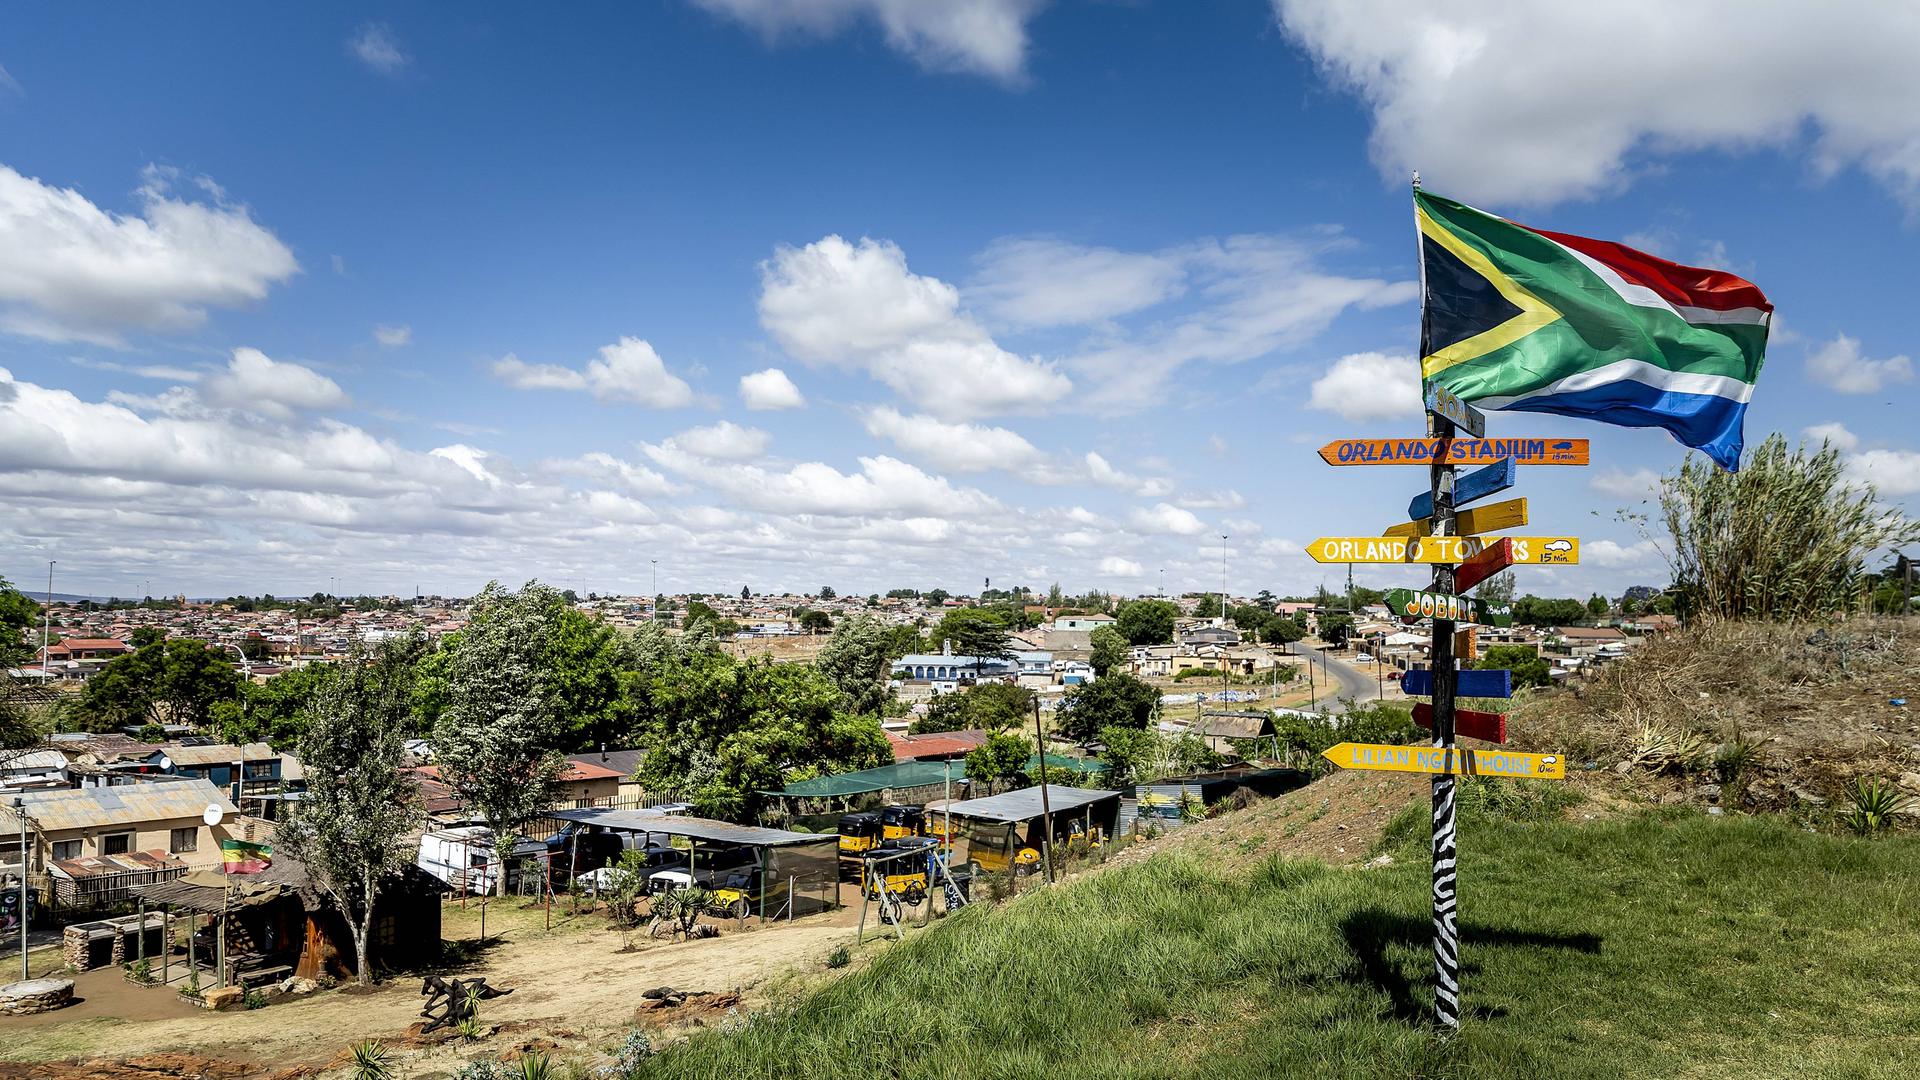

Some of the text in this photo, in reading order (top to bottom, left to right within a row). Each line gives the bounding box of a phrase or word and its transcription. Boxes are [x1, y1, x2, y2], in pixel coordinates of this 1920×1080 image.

[1338, 440, 1544, 462] ORLANDO STADIUM
[1324, 541, 1424, 561] ORLANDO
[1540, 553, 1552, 562] 15
[1406, 592, 1478, 623] JOBURG
[1353, 747, 1409, 766] LILIAN
[1482, 755, 1532, 774] HOUSE
[1537, 764, 1545, 773] 10
